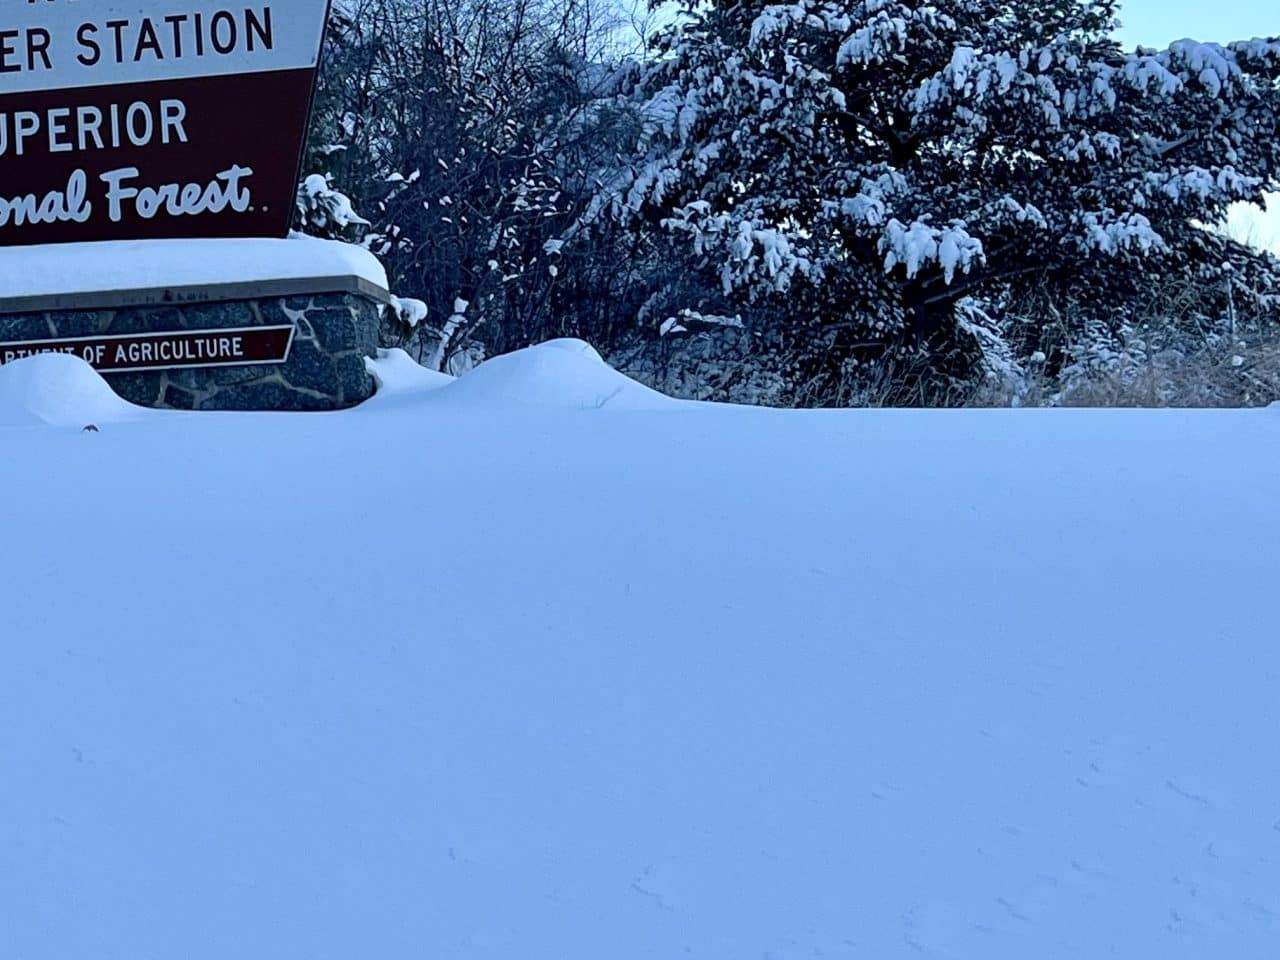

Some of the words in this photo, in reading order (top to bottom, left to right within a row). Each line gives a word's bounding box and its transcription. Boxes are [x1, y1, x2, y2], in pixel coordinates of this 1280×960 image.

[76, 6, 273, 66] STATION
[100, 164, 254, 222] Forest
[82, 345, 106, 364] OF
[114, 337, 244, 364] AGRICULTURE
